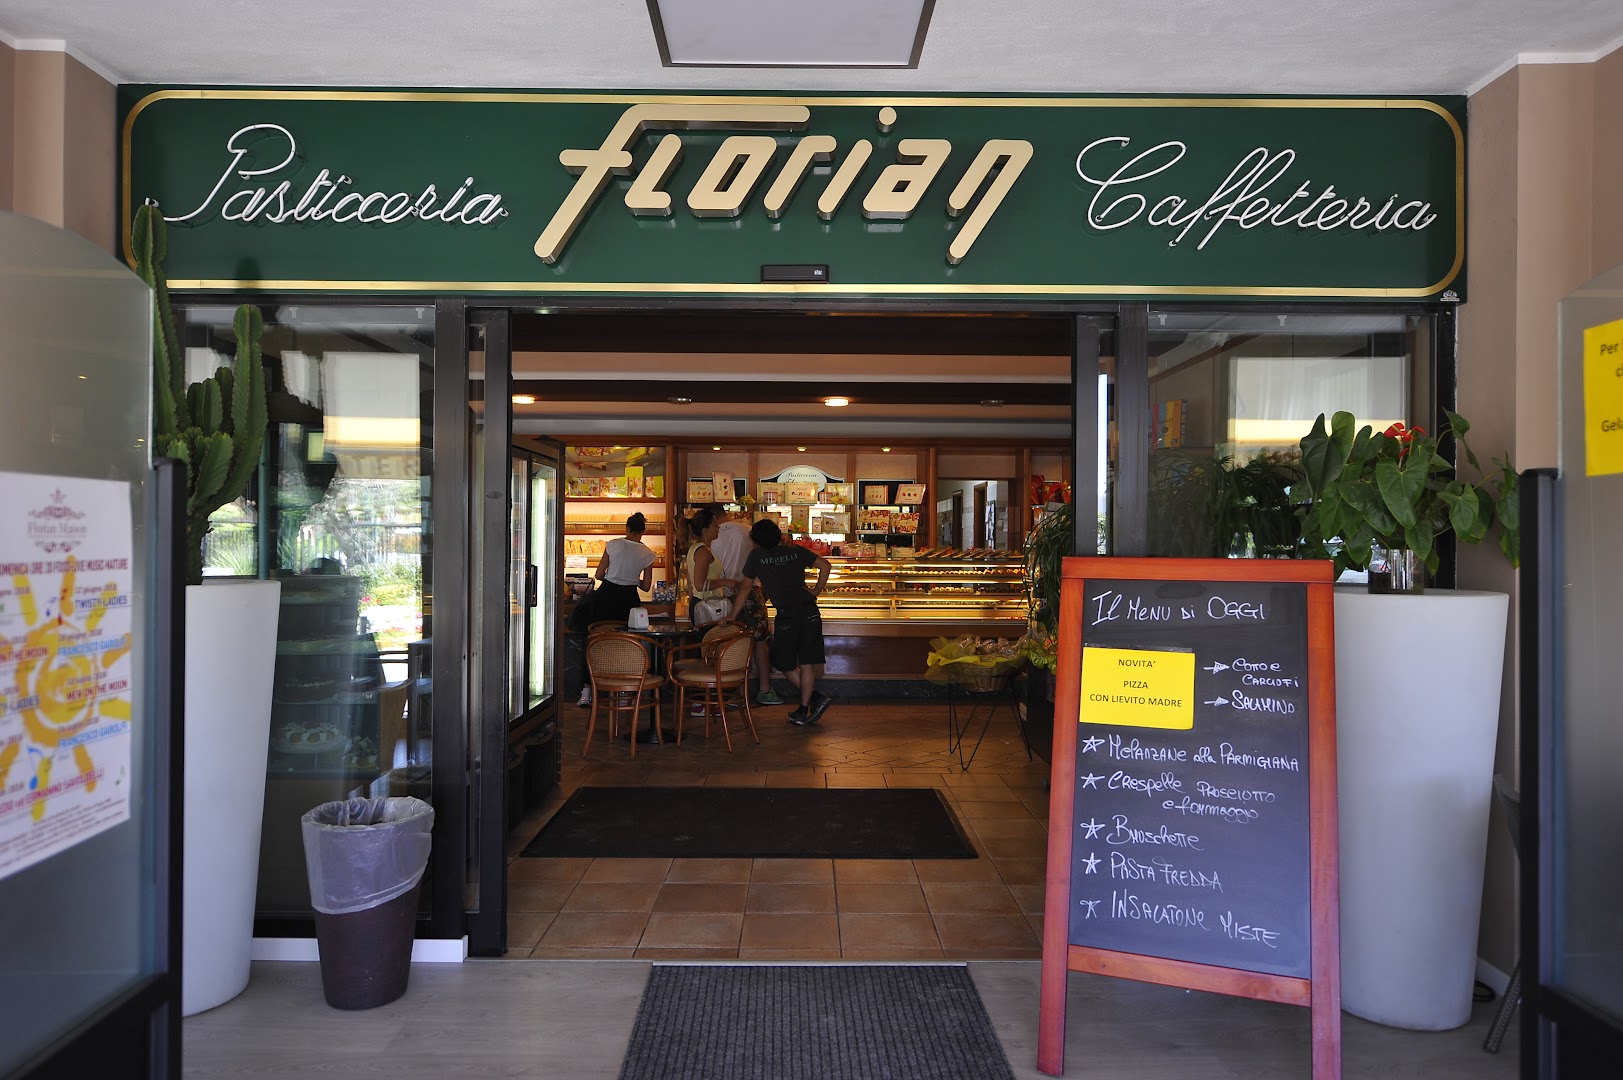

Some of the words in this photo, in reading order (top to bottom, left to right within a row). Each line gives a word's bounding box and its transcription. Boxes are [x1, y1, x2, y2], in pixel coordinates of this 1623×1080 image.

[148, 123, 508, 224] Pasticceria
[533, 103, 1034, 265] Florian
[1075, 136, 1437, 251] Caffetteria
[1600, 343, 1619, 356] Per
[1092, 590, 1122, 625] Il
[1089, 693, 1109, 702] CON
[1111, 695, 1146, 705] LIEVITO
[1148, 697, 1183, 708] MADRE
[1123, 680, 1149, 689] PIZZA
